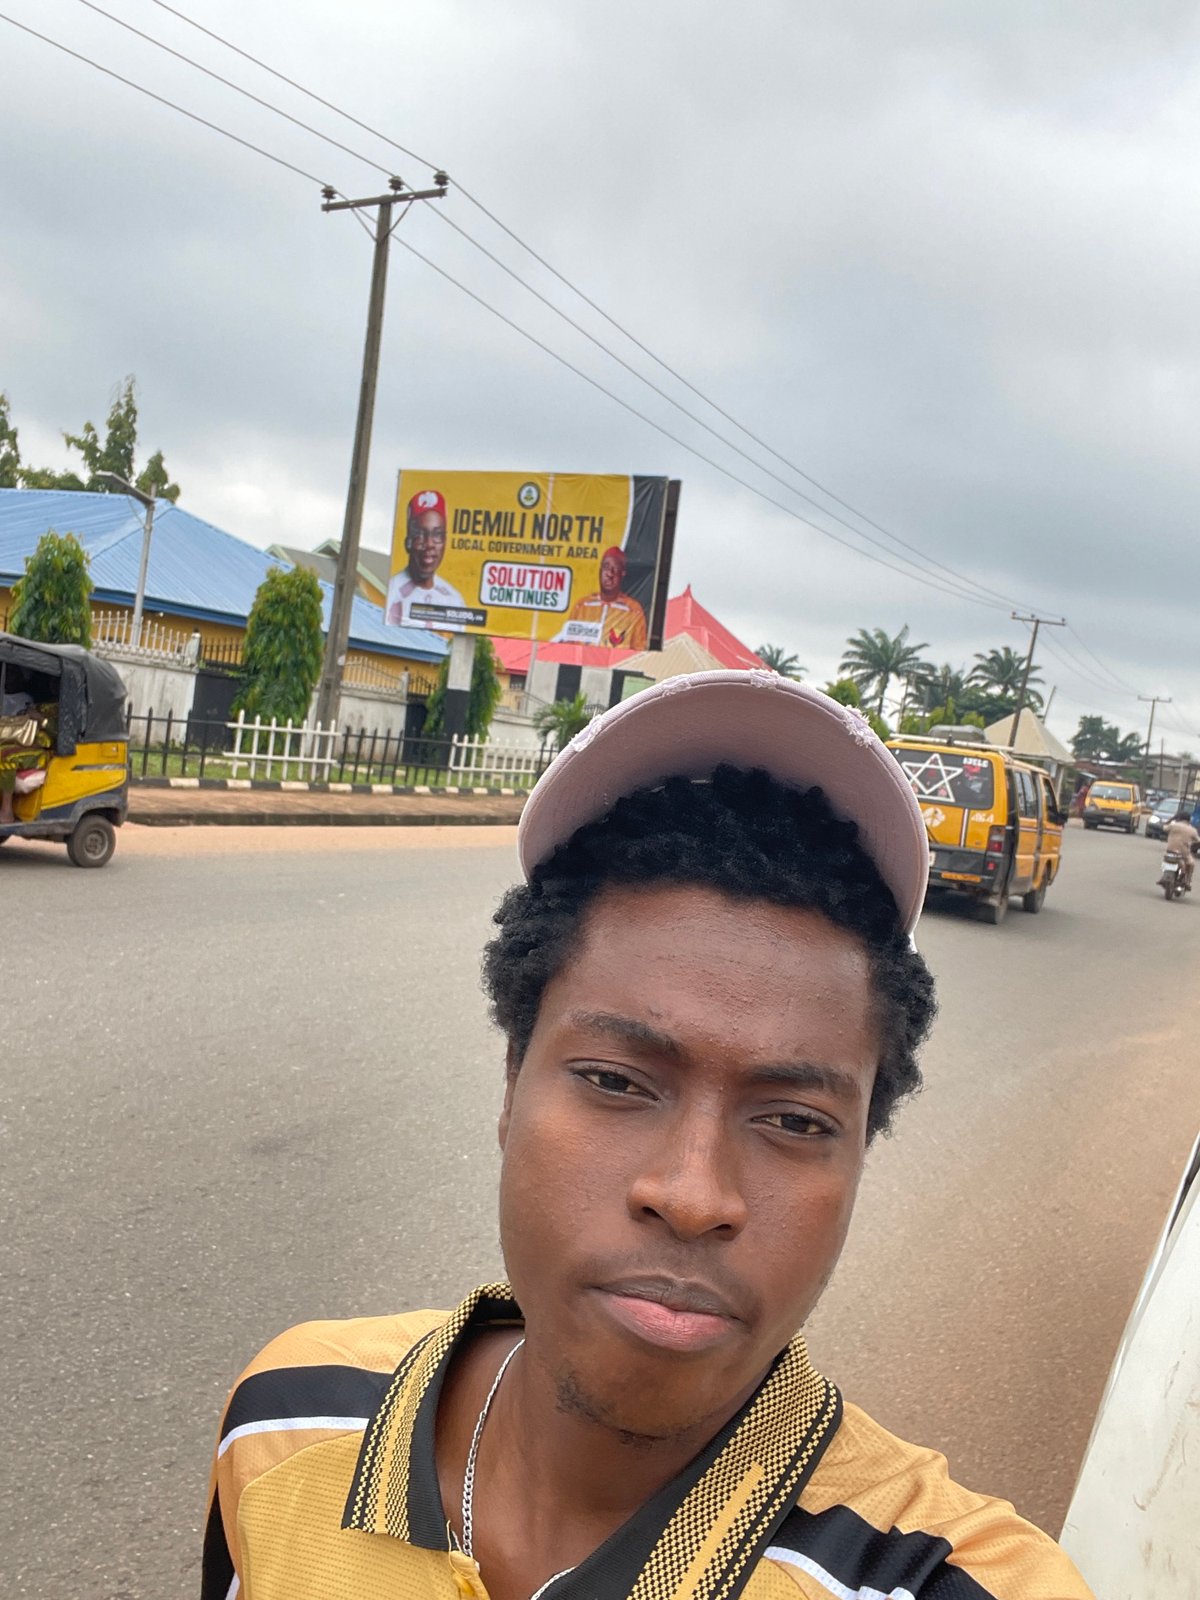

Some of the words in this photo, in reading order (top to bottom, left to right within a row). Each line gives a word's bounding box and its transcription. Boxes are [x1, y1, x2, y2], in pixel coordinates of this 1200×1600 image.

[453, 509, 525, 538] IDEMILI
[532, 514, 603, 543] NORTH
[452, 538, 484, 551] LOCAL
[488, 541, 563, 556] GOVERNMENT
[567, 546, 598, 559] AREA
[487, 566, 565, 591] SOLUTION
[489, 587, 559, 607] CONTINUES
